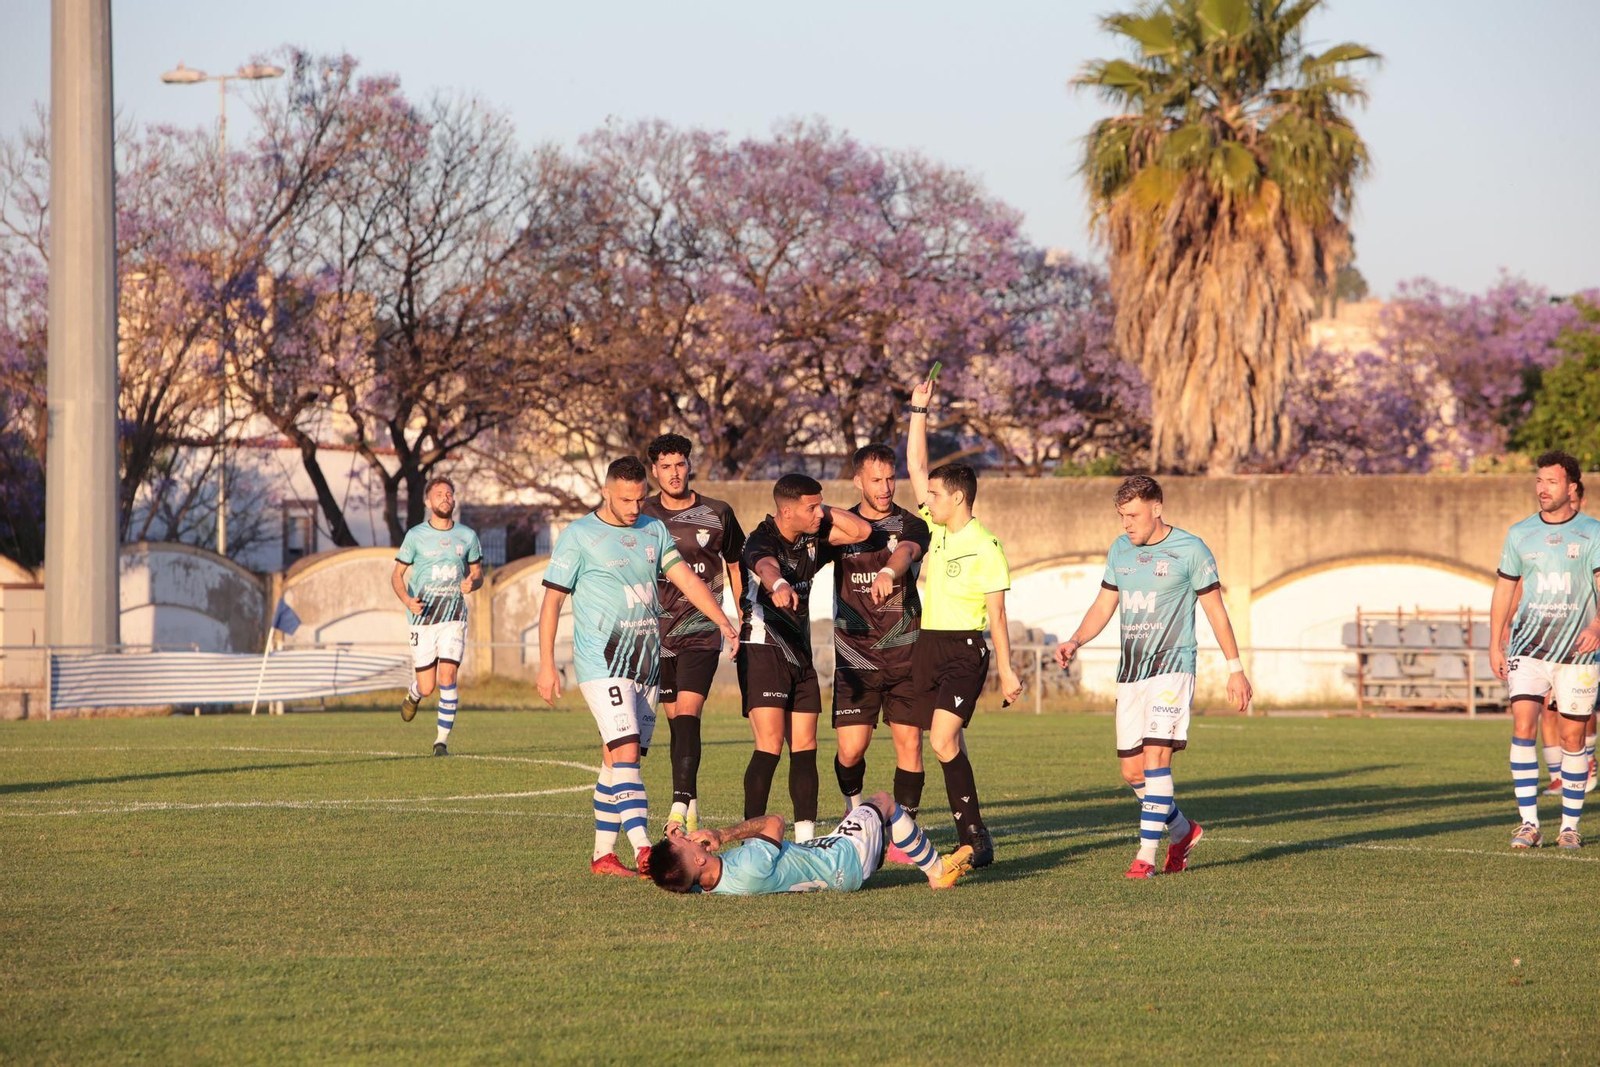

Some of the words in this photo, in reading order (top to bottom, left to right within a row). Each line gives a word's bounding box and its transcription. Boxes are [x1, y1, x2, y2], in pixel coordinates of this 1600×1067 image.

[693, 563, 705, 573] 10
[851, 572, 879, 584] GRUP
[608, 685, 623, 706] 9
[1152, 705, 1182, 714] newcar
